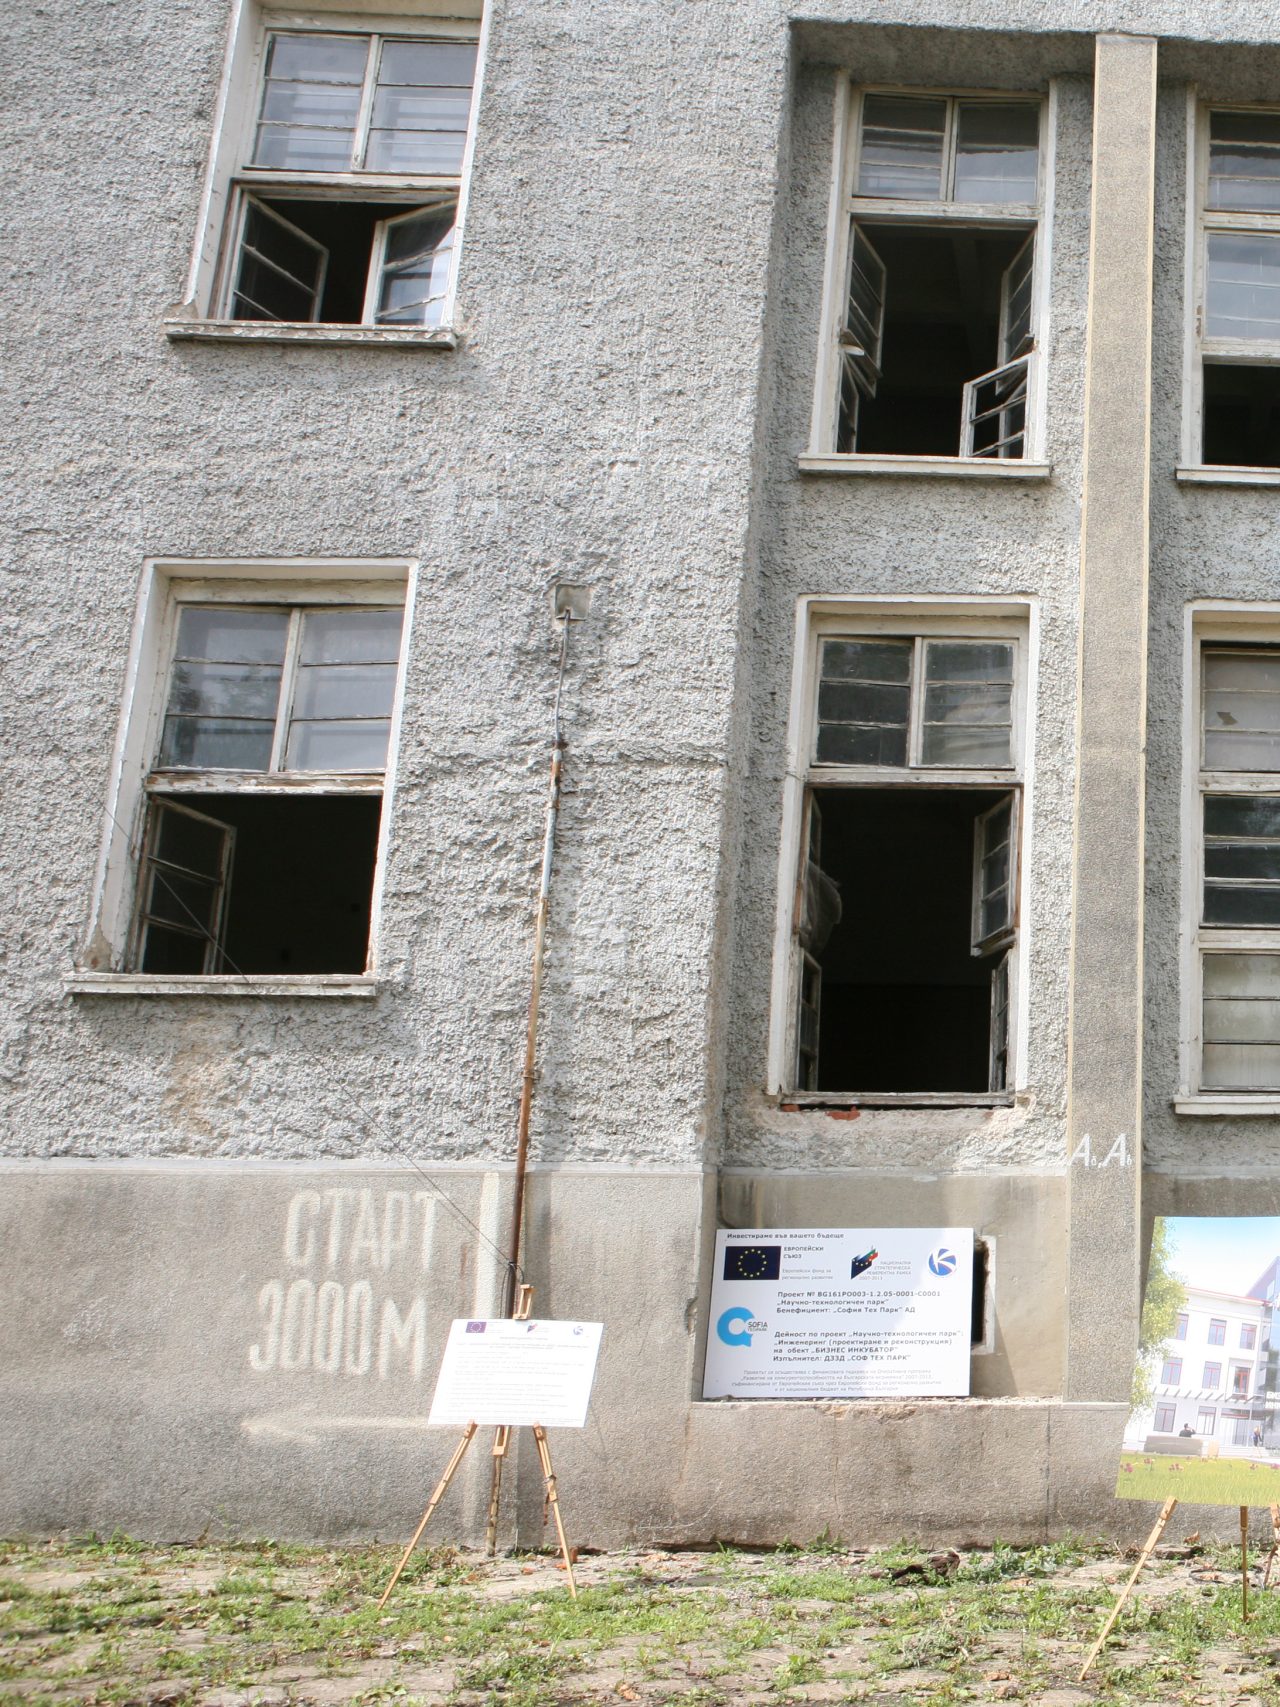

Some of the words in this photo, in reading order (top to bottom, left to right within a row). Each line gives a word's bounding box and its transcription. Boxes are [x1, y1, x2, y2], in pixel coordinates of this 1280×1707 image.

[284, 1188, 447, 1271] СТАРТ
[776, 1306, 831, 1314] Бенефициент:
[774, 1330, 806, 1338] Дейност
